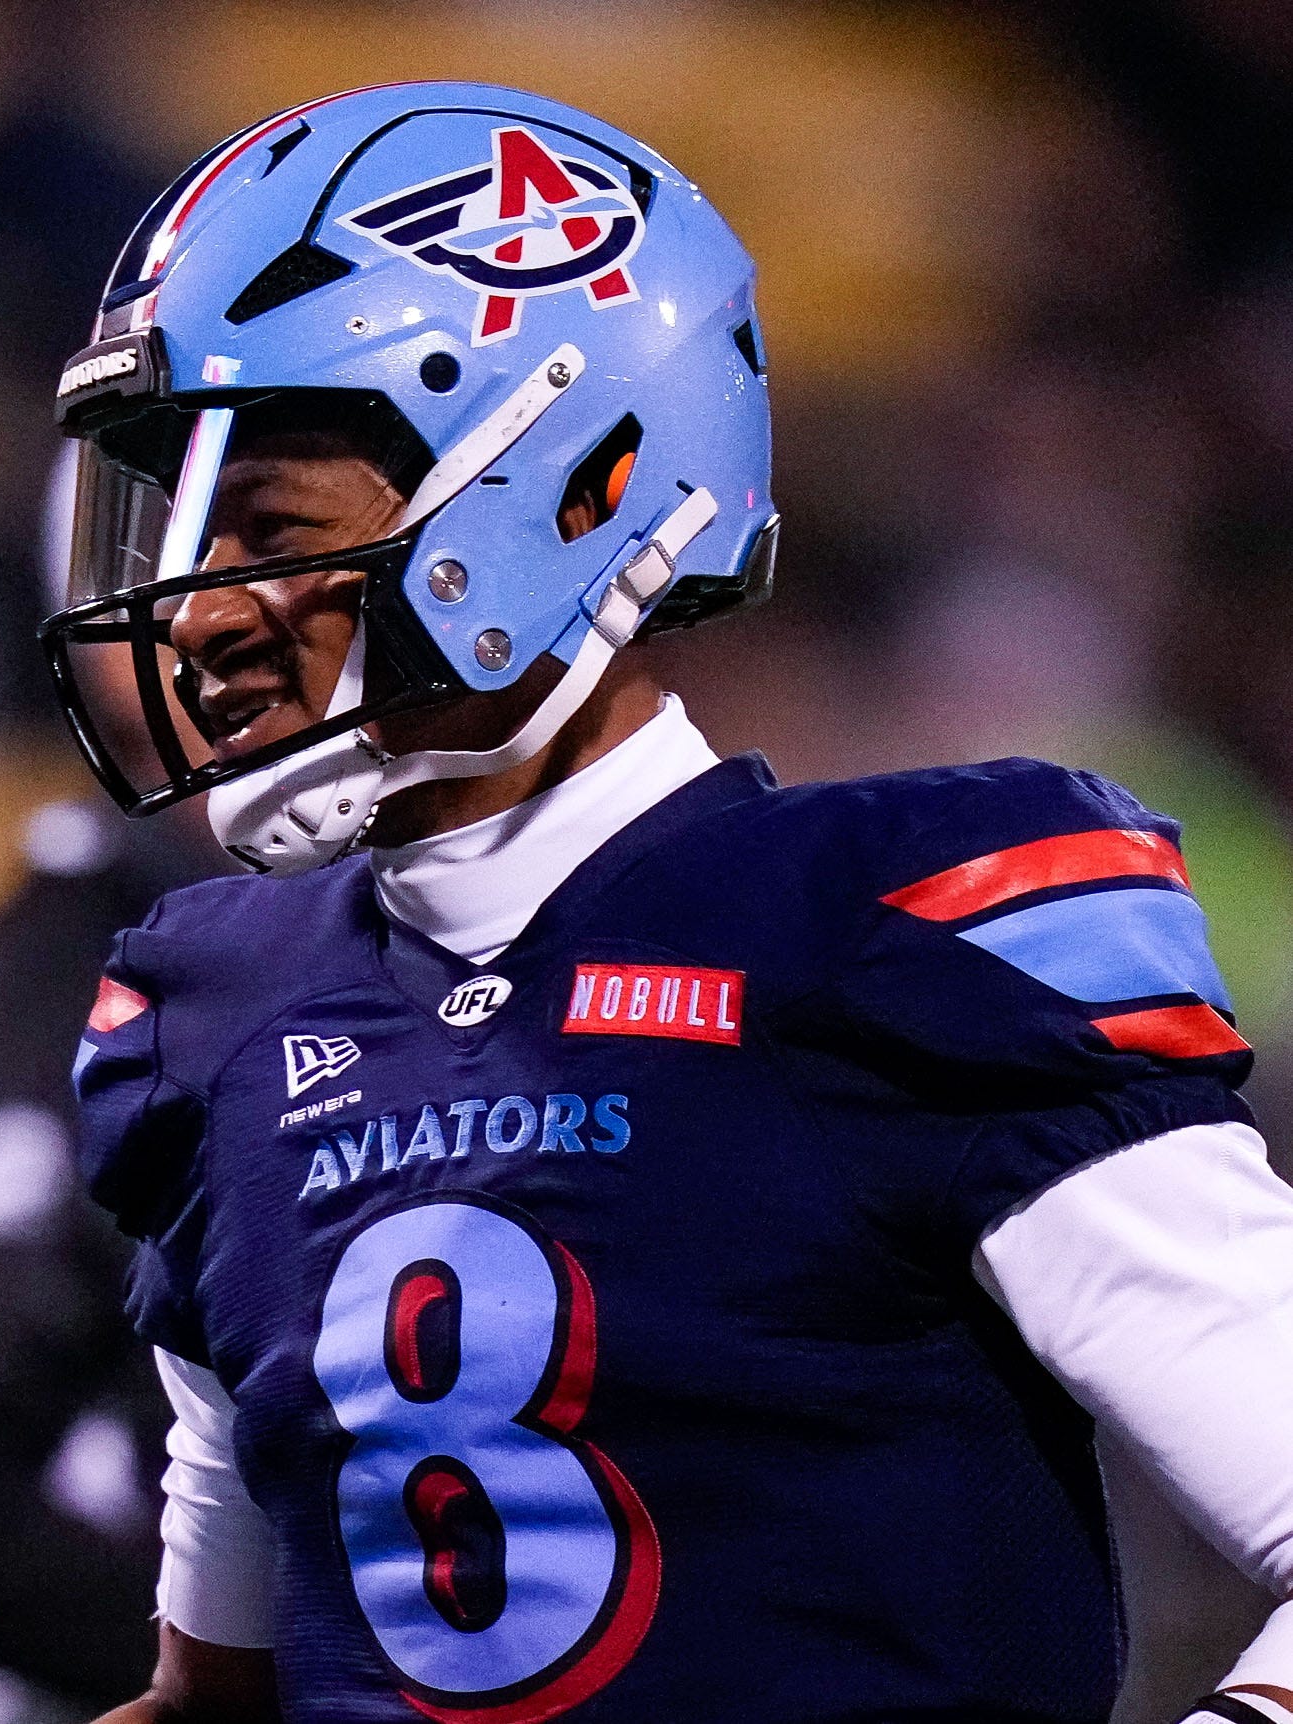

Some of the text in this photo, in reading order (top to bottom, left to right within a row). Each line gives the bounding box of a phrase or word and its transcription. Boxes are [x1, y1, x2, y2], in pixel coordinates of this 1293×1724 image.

[444, 986, 500, 1017] UFL
[569, 974, 736, 1030] NOBULL
[298, 1093, 631, 1201] AVIATORS
[313, 1202, 661, 1723] 8
